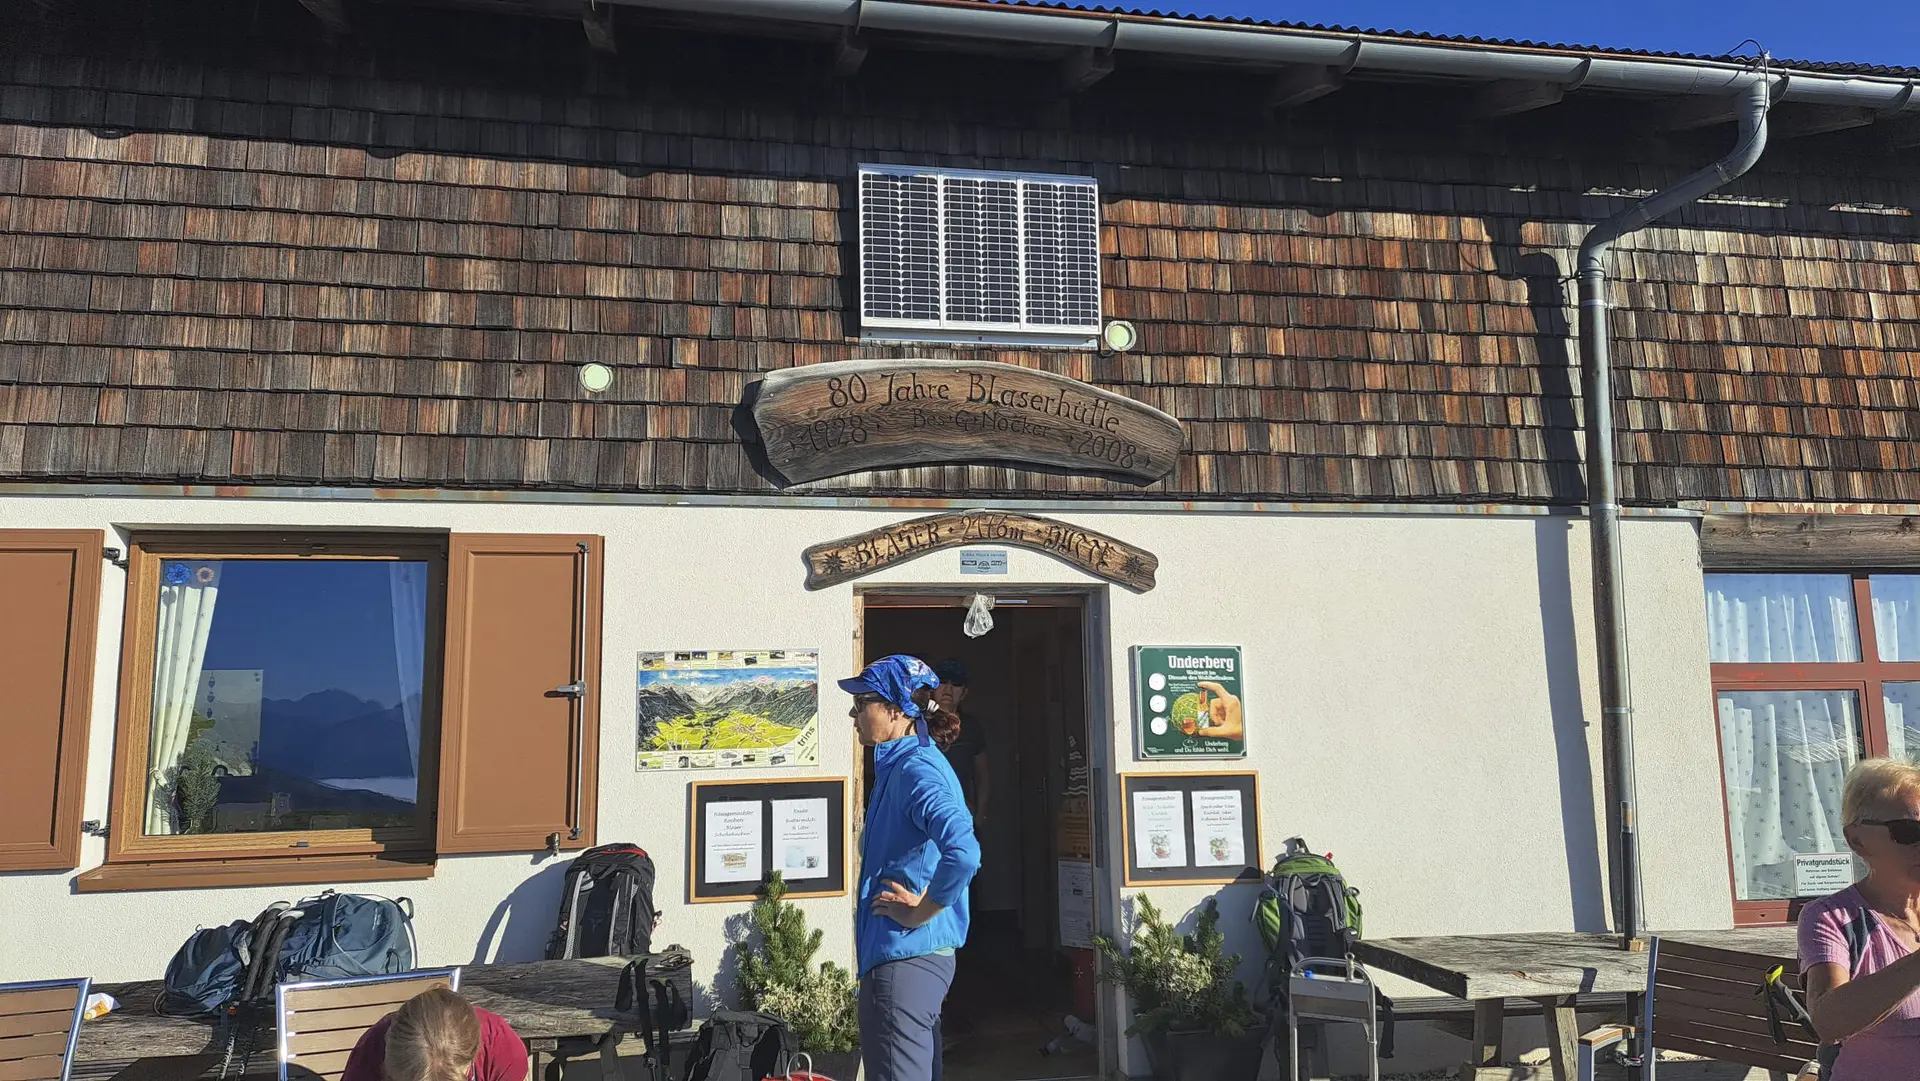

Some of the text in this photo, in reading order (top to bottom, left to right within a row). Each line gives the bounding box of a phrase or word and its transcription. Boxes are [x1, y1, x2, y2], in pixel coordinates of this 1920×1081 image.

[828, 373, 867, 408] 80
[880, 372, 949, 407] Jahre
[798, 414, 867, 451] 1928
[1077, 430, 1137, 469] 2008
[854, 521, 942, 570] BLASER
[1167, 655, 1235, 673] Underberg
[797, 726, 815, 747] trins
[1205, 740, 1230, 749] Underberg
[1796, 857, 1850, 868] Privatgrundstück
